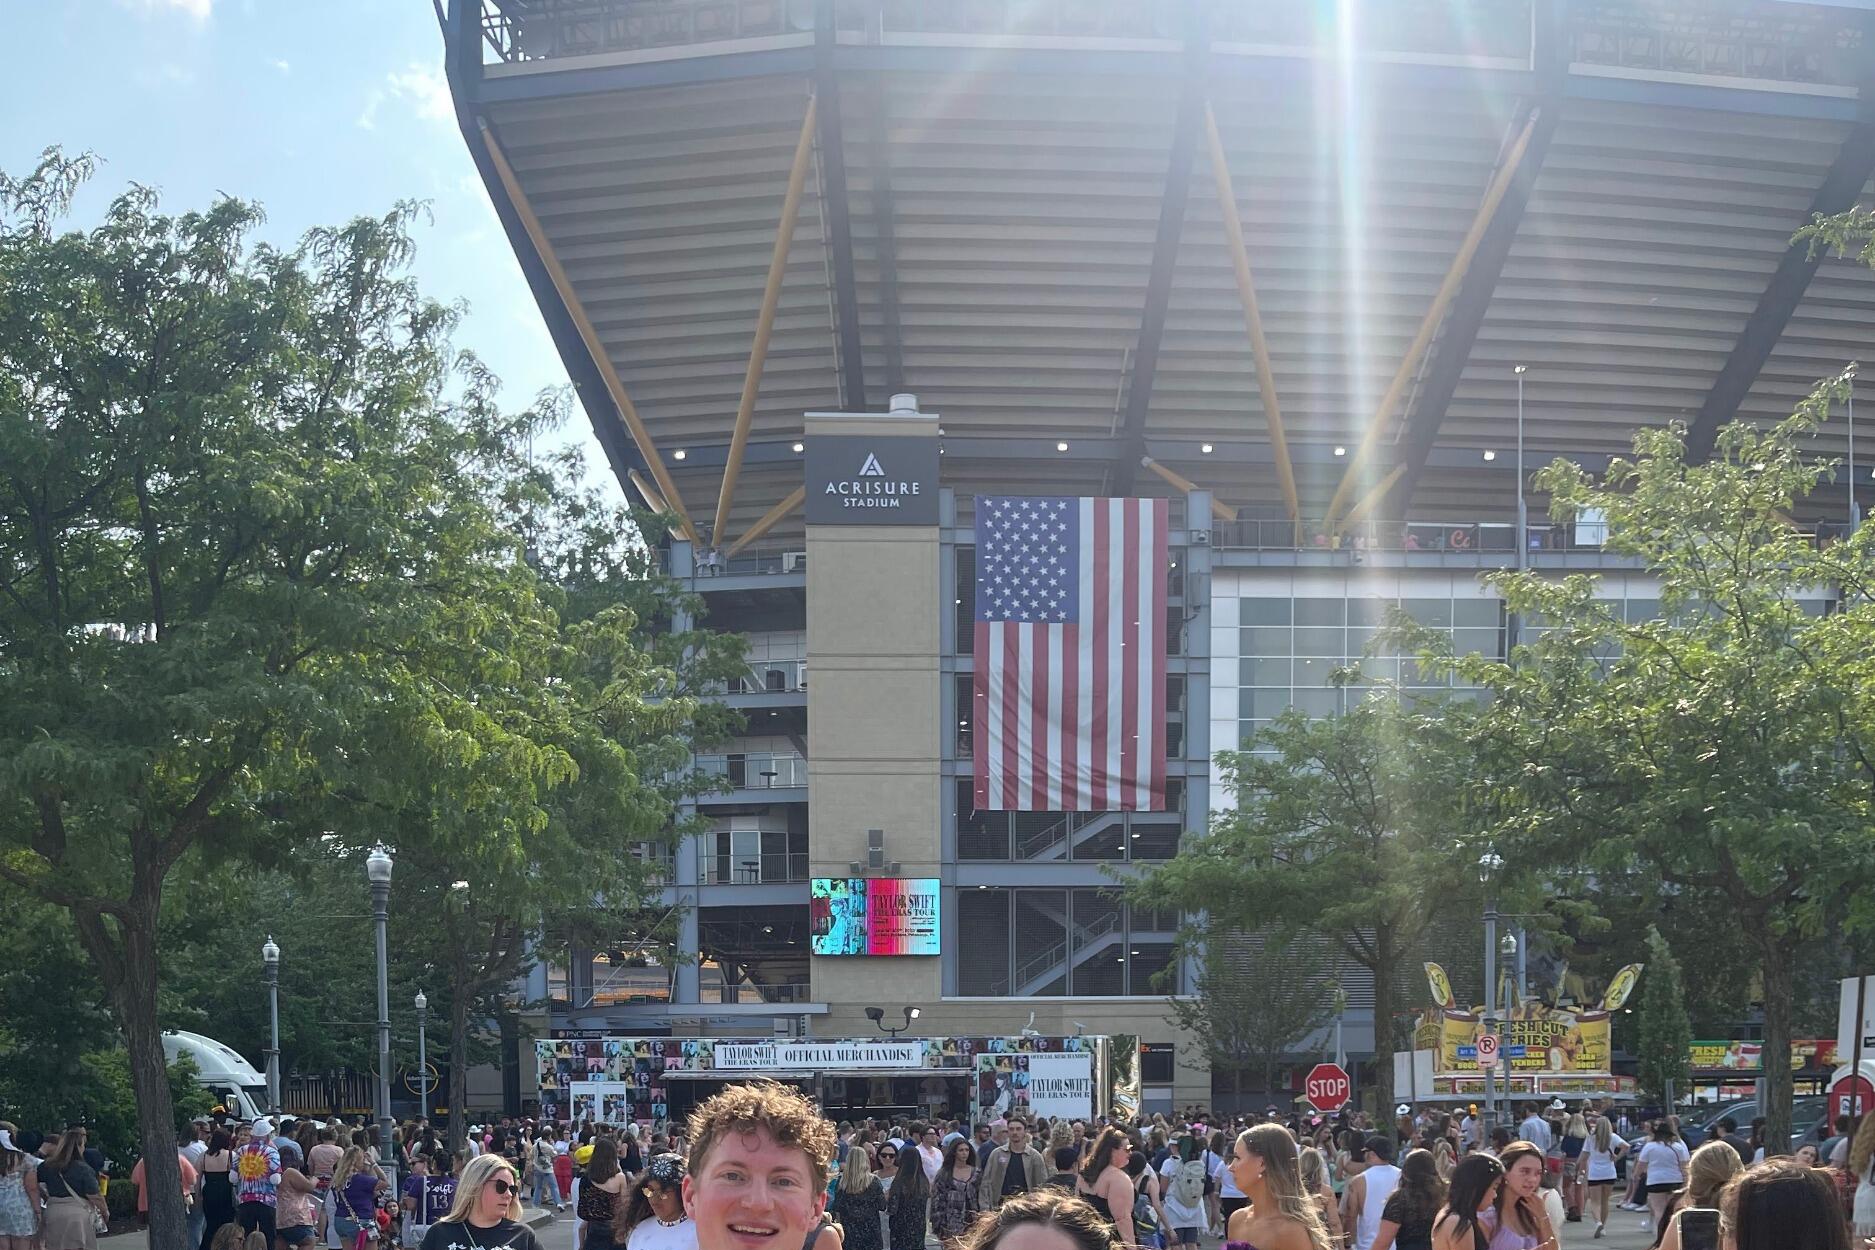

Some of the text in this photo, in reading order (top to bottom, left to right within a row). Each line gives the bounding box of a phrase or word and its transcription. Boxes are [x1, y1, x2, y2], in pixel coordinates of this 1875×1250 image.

[825, 481, 920, 495] ACRISURE
[843, 498, 900, 508] STADIUM
[872, 894, 936, 909] TAYLOR SWIFT
[891, 909, 912, 917] ERAS
[914, 909, 936, 917] TOUR
[566, 1030, 582, 1038] PNC
[1541, 1020, 1569, 1037] CUT
[722, 1046, 778, 1060] TAYLOR SWIFT
[784, 1048, 914, 1062] OFFICIAL MERCHANDISE
[1031, 1078, 1089, 1092] TAYLOR SWIFT
[1309, 1078, 1347, 1098] STOP
[431, 1194, 449, 1210] 13
